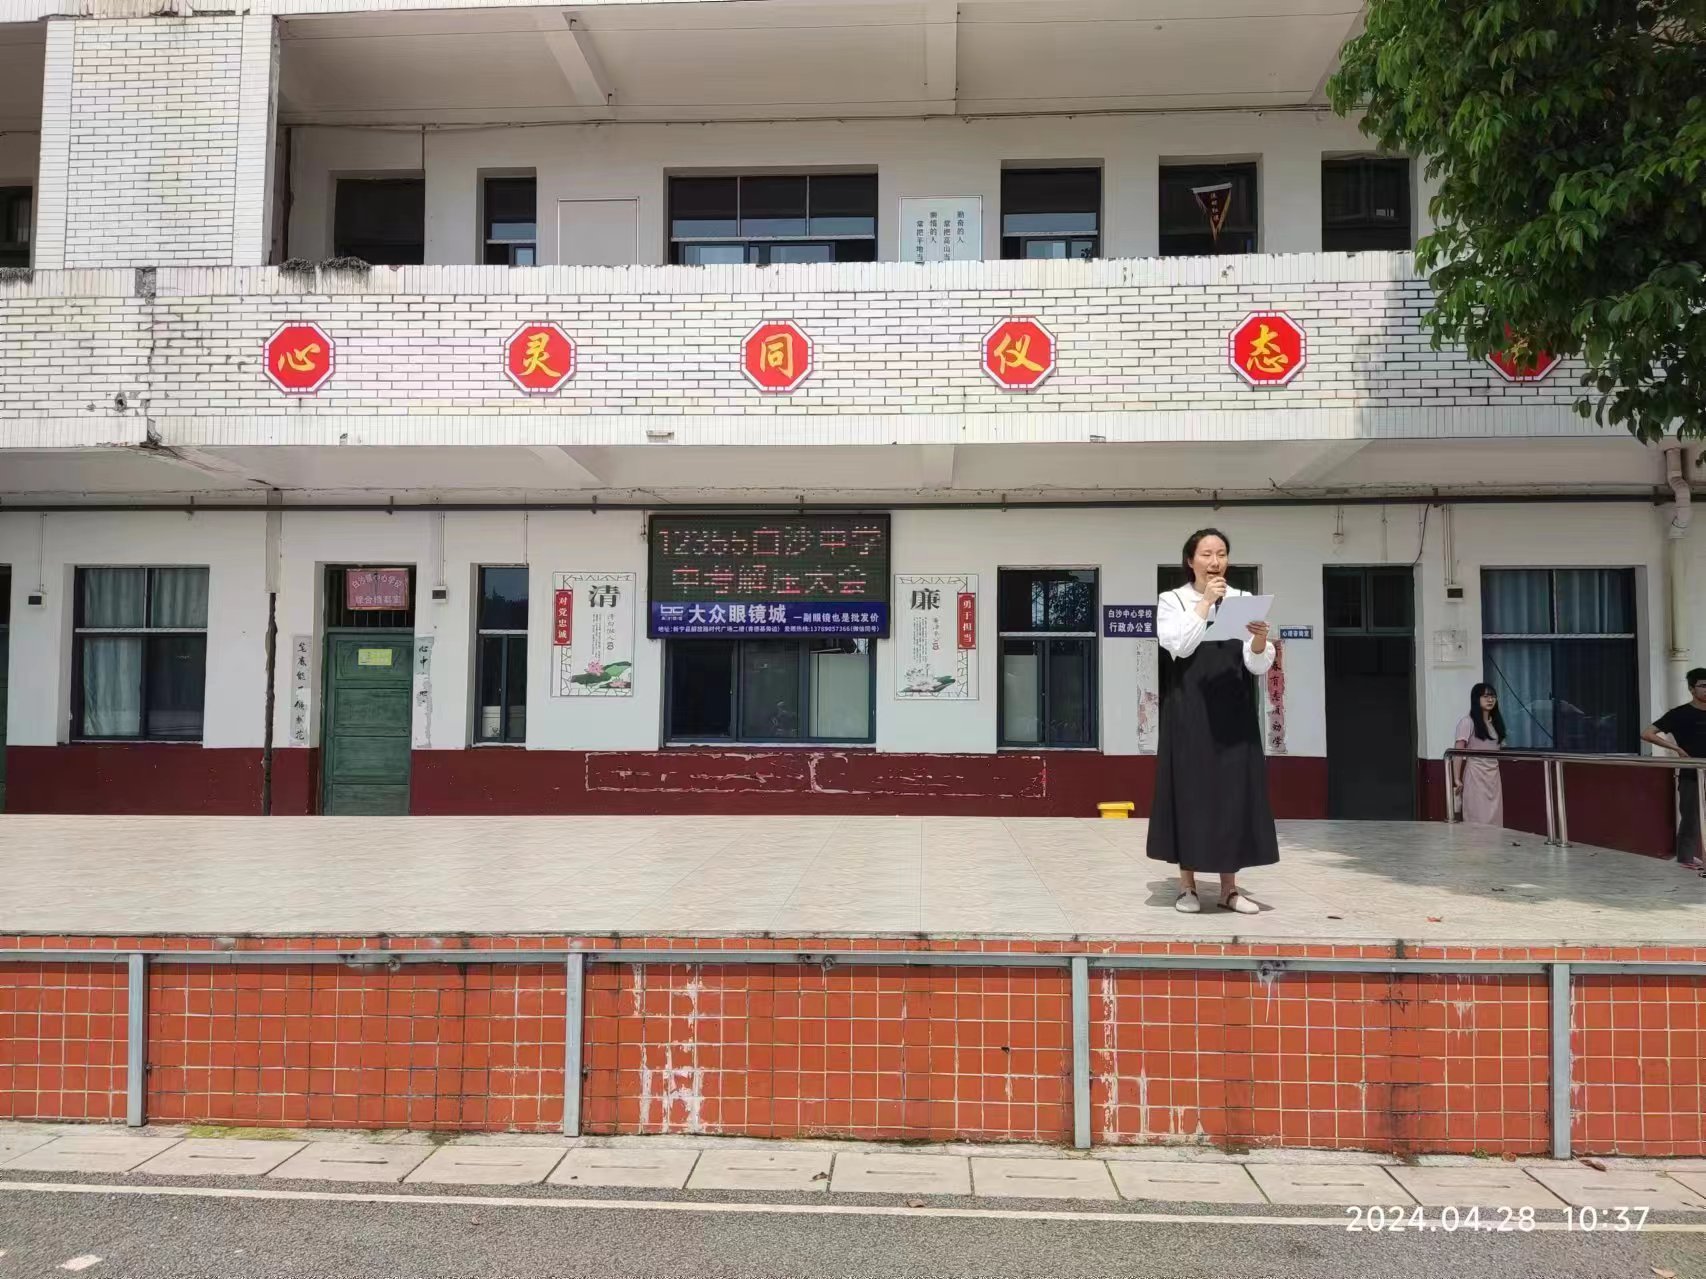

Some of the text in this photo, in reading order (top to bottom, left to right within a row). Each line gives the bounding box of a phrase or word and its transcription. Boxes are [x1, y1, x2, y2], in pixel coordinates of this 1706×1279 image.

[277, 324, 1289, 378] 心 灵 同 仪 态
[588, 584, 620, 608] 清
[910, 588, 941, 610] 廉
[558, 596, 567, 639] 对党忠诚
[688, 604, 787, 624] 大众眼镜城
[963, 600, 972, 643] 勇于担当
[1108, 609, 1152, 618] 白沙中心学校
[1109, 622, 1152, 633] 行政办公室
